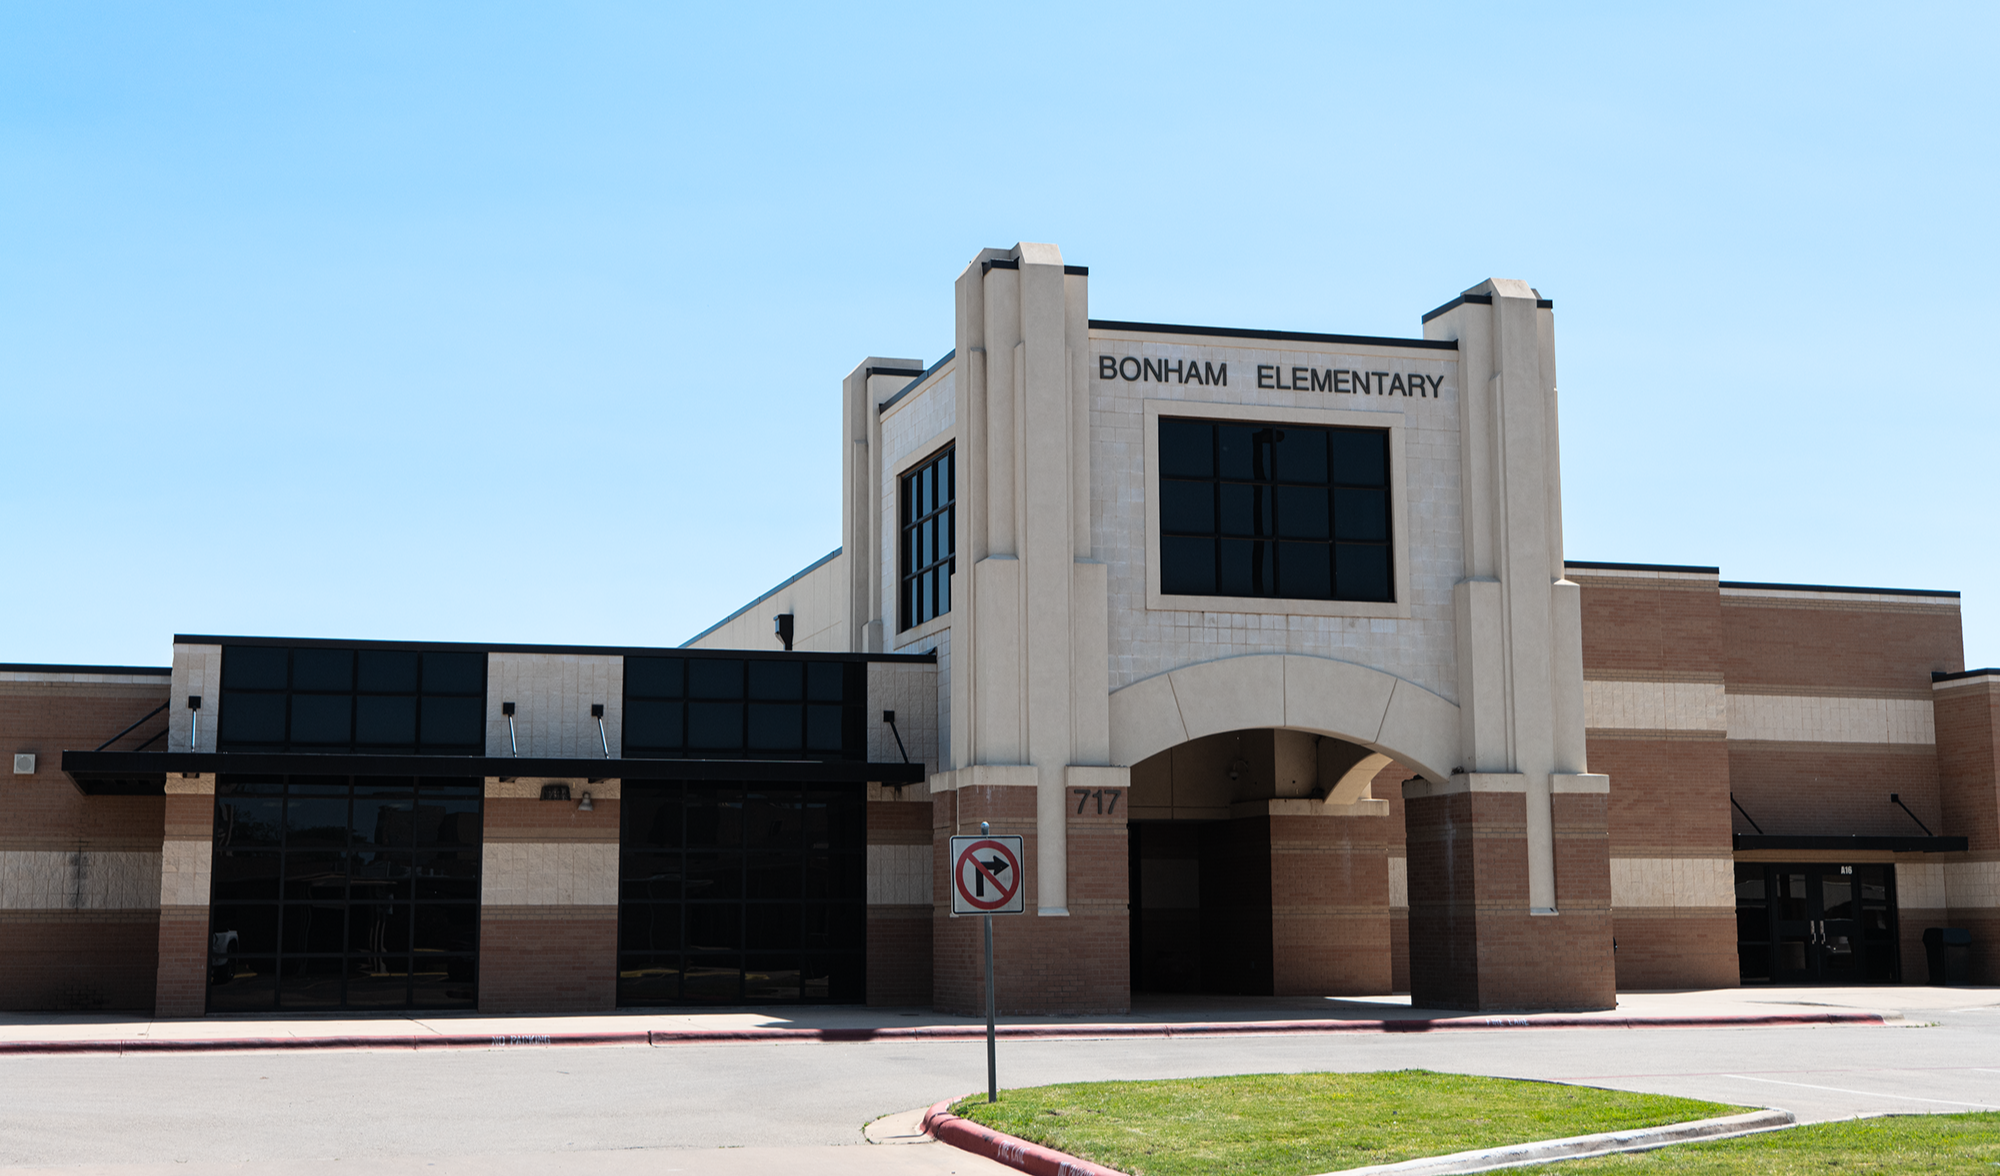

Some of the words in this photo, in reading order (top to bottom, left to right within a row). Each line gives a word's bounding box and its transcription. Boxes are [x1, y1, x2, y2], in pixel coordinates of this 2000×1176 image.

[1098, 355, 1228, 387] BONHAM
[1257, 365, 1444, 399] ELEMENTARY
[1073, 788, 1122, 815] 717
[491, 1036, 506, 1047] NO
[510, 1035, 550, 1046] PARKING
